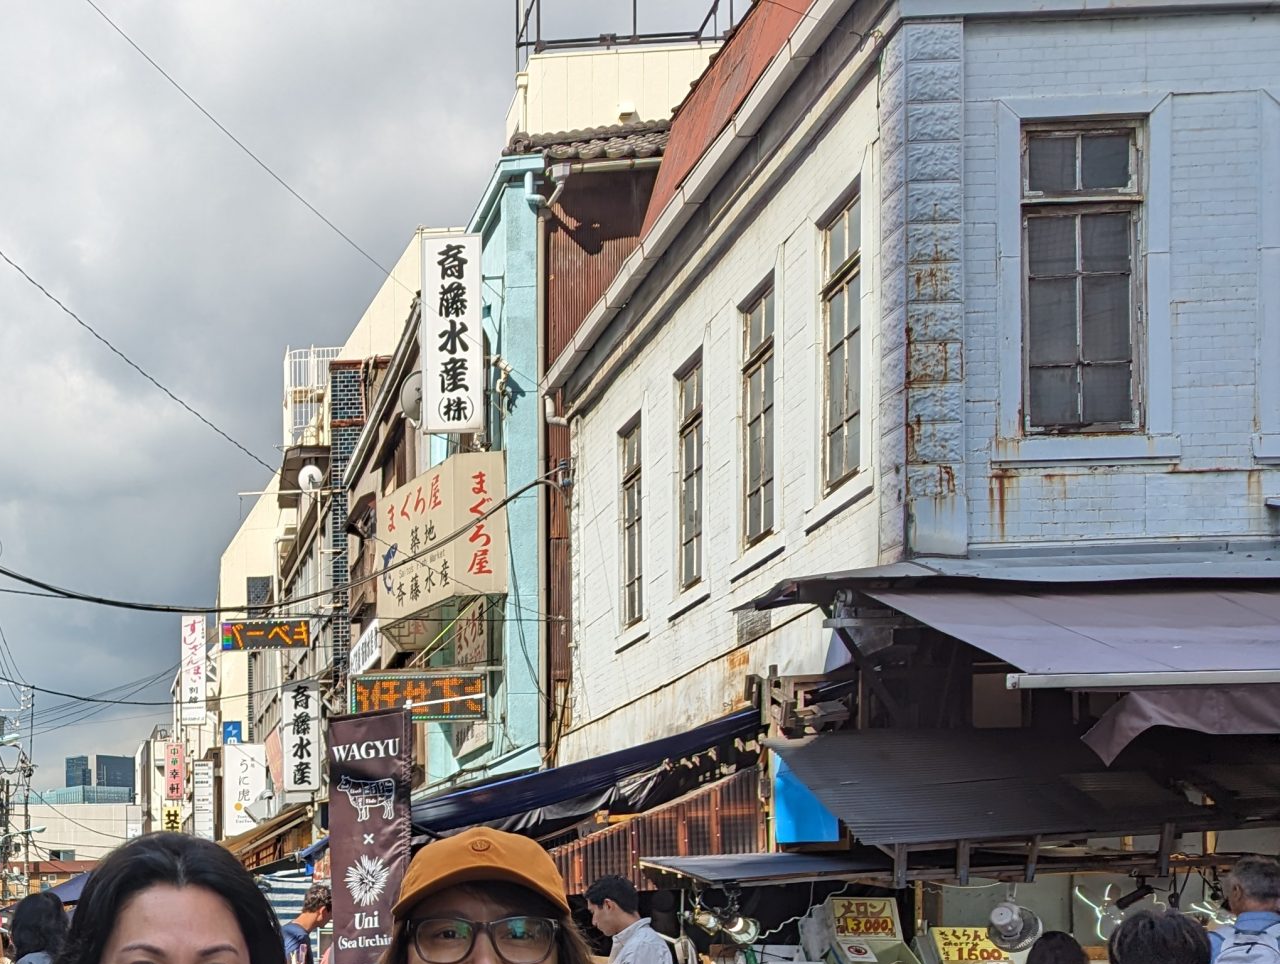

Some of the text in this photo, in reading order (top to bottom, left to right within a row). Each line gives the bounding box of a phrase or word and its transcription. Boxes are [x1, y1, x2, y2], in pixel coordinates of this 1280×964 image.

[387, 474, 442, 533] まぐろ屋
[467, 471, 493, 575] まぐろ屋
[332, 737, 400, 762] WAGYU
[237, 758, 251, 802] うに虎
[354, 910, 380, 930] Uni
[834, 900, 887, 918] メロン
[338, 935, 357, 950] (Sea
